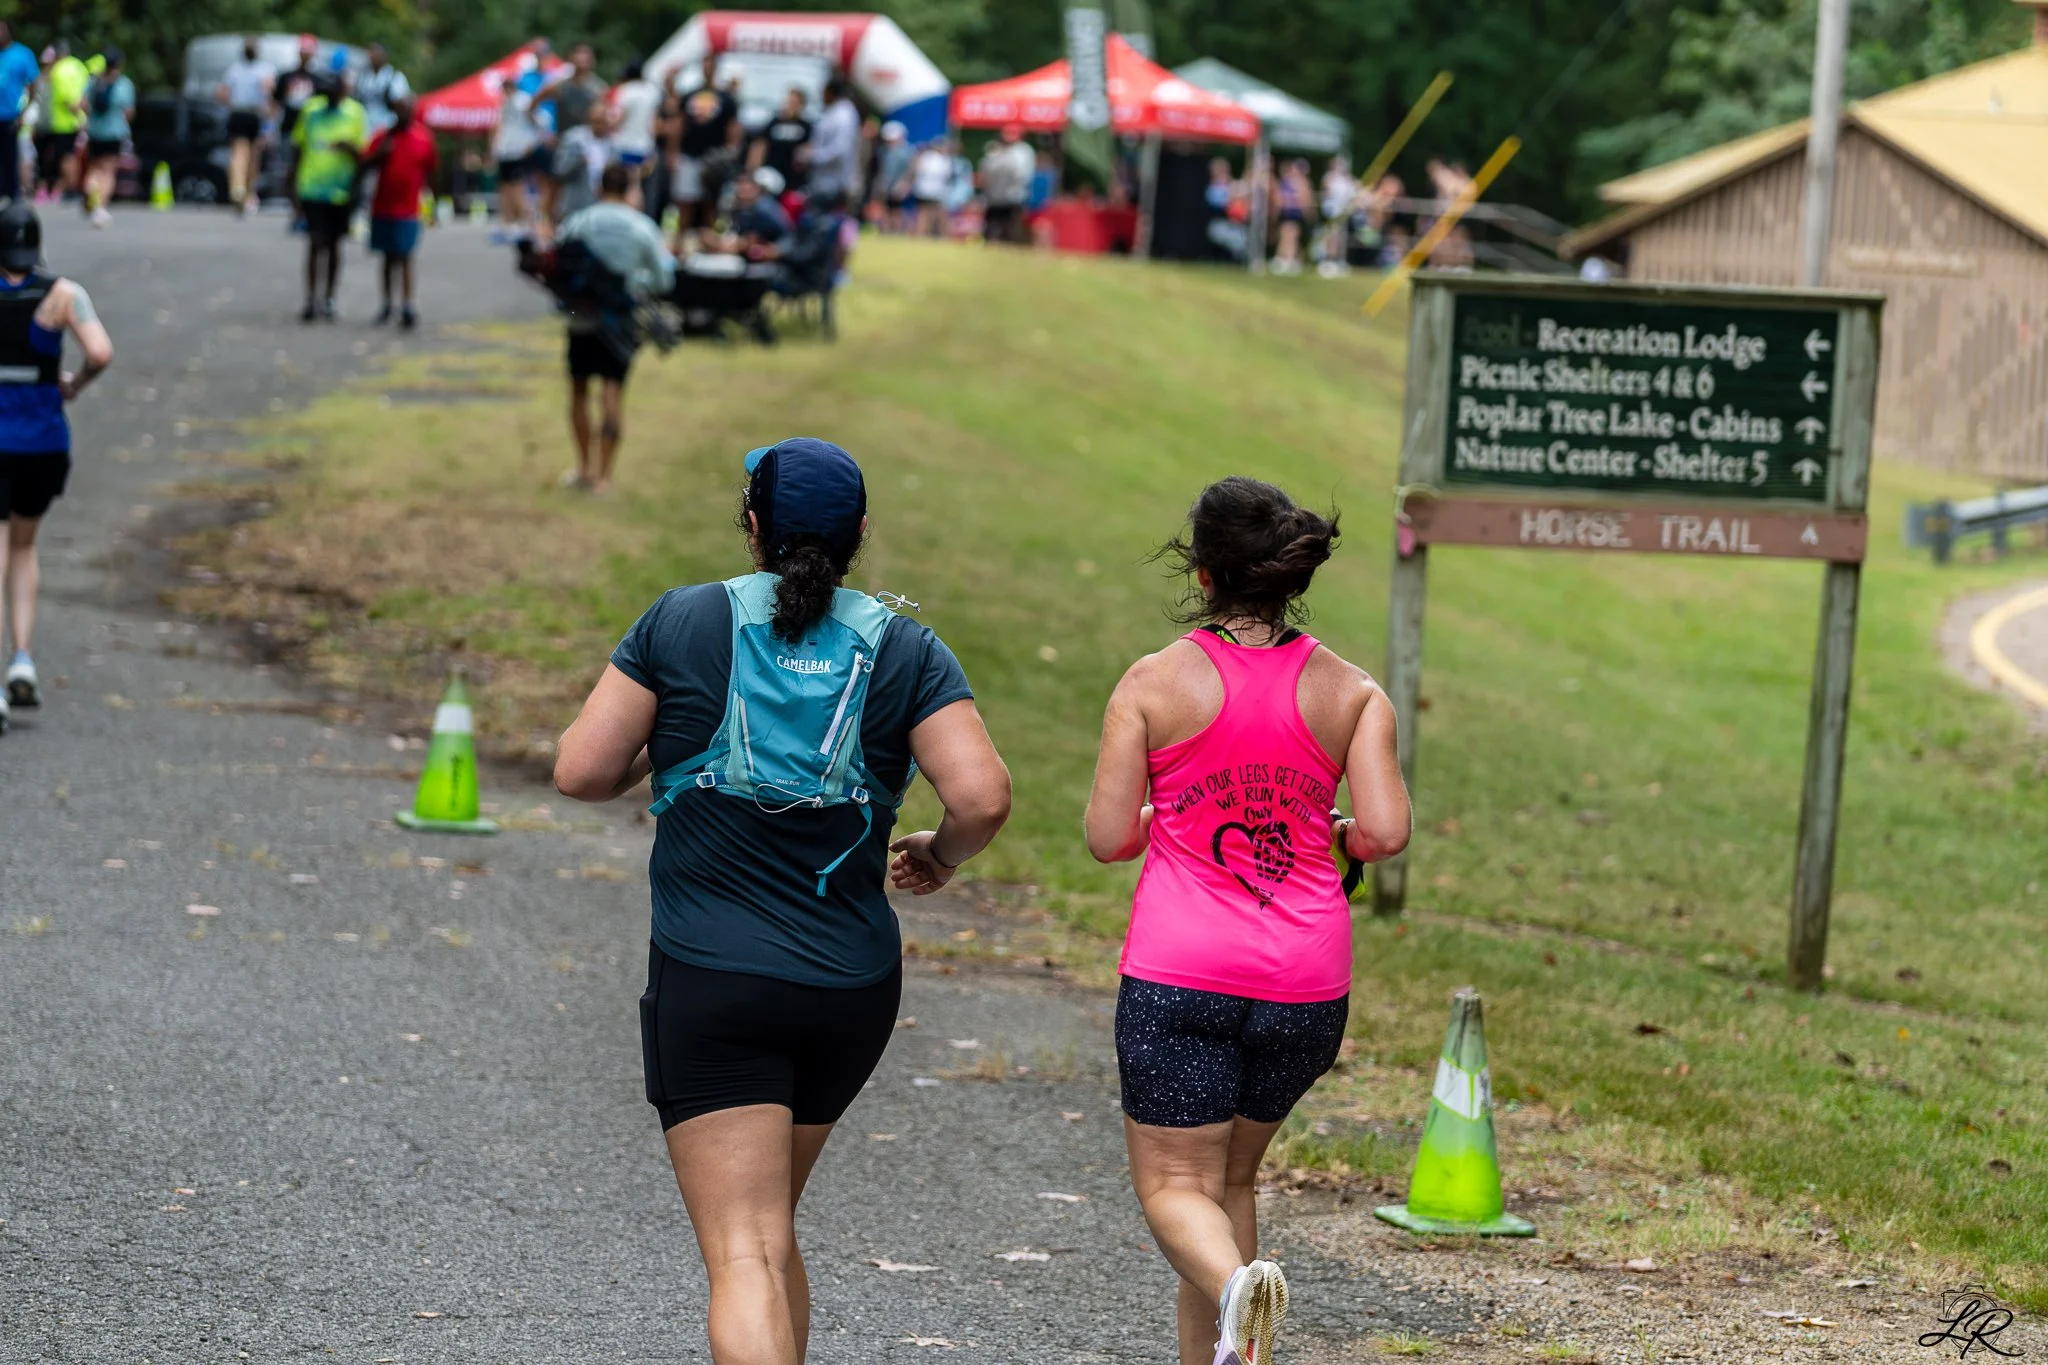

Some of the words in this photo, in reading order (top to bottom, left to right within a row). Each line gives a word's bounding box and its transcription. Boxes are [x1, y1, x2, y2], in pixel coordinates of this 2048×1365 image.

[1537, 317, 1681, 358] Recreation
[1682, 323, 1767, 371] Lodge
[1460, 354, 1543, 391] Picnic
[1543, 355, 1651, 396] Shelters
[1652, 364, 1672, 398] 4
[1672, 364, 1694, 399] &
[1695, 363, 1716, 400] 6
[1457, 393, 1544, 439] Poplar
[1546, 399, 1608, 436] Tree
[1608, 400, 1676, 439] Lake
[1689, 403, 1783, 445] Cabins
[1454, 435, 1546, 474] Nature
[1547, 439, 1639, 478] Center
[1653, 441, 1749, 484] Shelter
[1750, 449, 1770, 488] 5
[1519, 507, 1632, 548] HORSE
[1656, 511, 1762, 554] TRAIL
[776, 655, 832, 674] CAMELBAK
[1171, 781, 1205, 815] WHEN
[1205, 768, 1235, 794] OUR
[1238, 763, 1270, 785] LEGS
[1275, 765, 1299, 789] GET
[1299, 773, 1330, 805] TIRED
[1215, 789, 1241, 811] WE
[1245, 786, 1274, 803] RUN
[1279, 791, 1312, 825] WITH
